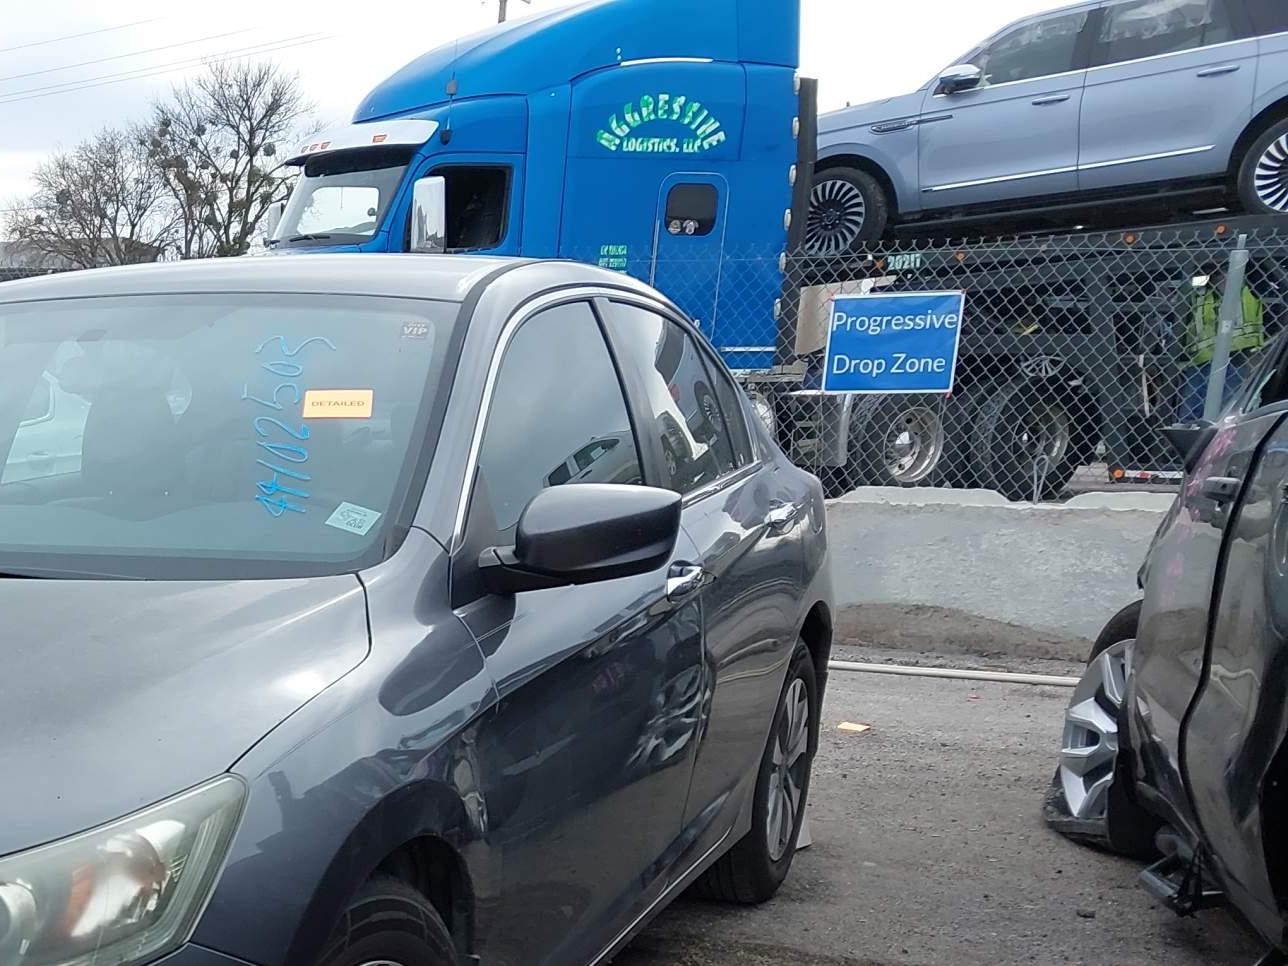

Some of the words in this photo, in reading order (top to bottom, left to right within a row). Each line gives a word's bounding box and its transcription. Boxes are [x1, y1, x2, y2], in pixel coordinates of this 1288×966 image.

[597, 93, 726, 151] AGGRESSIVE
[832, 310, 958, 335] Progressive
[832, 355, 886, 377] Drop
[890, 353, 946, 374] Zone
